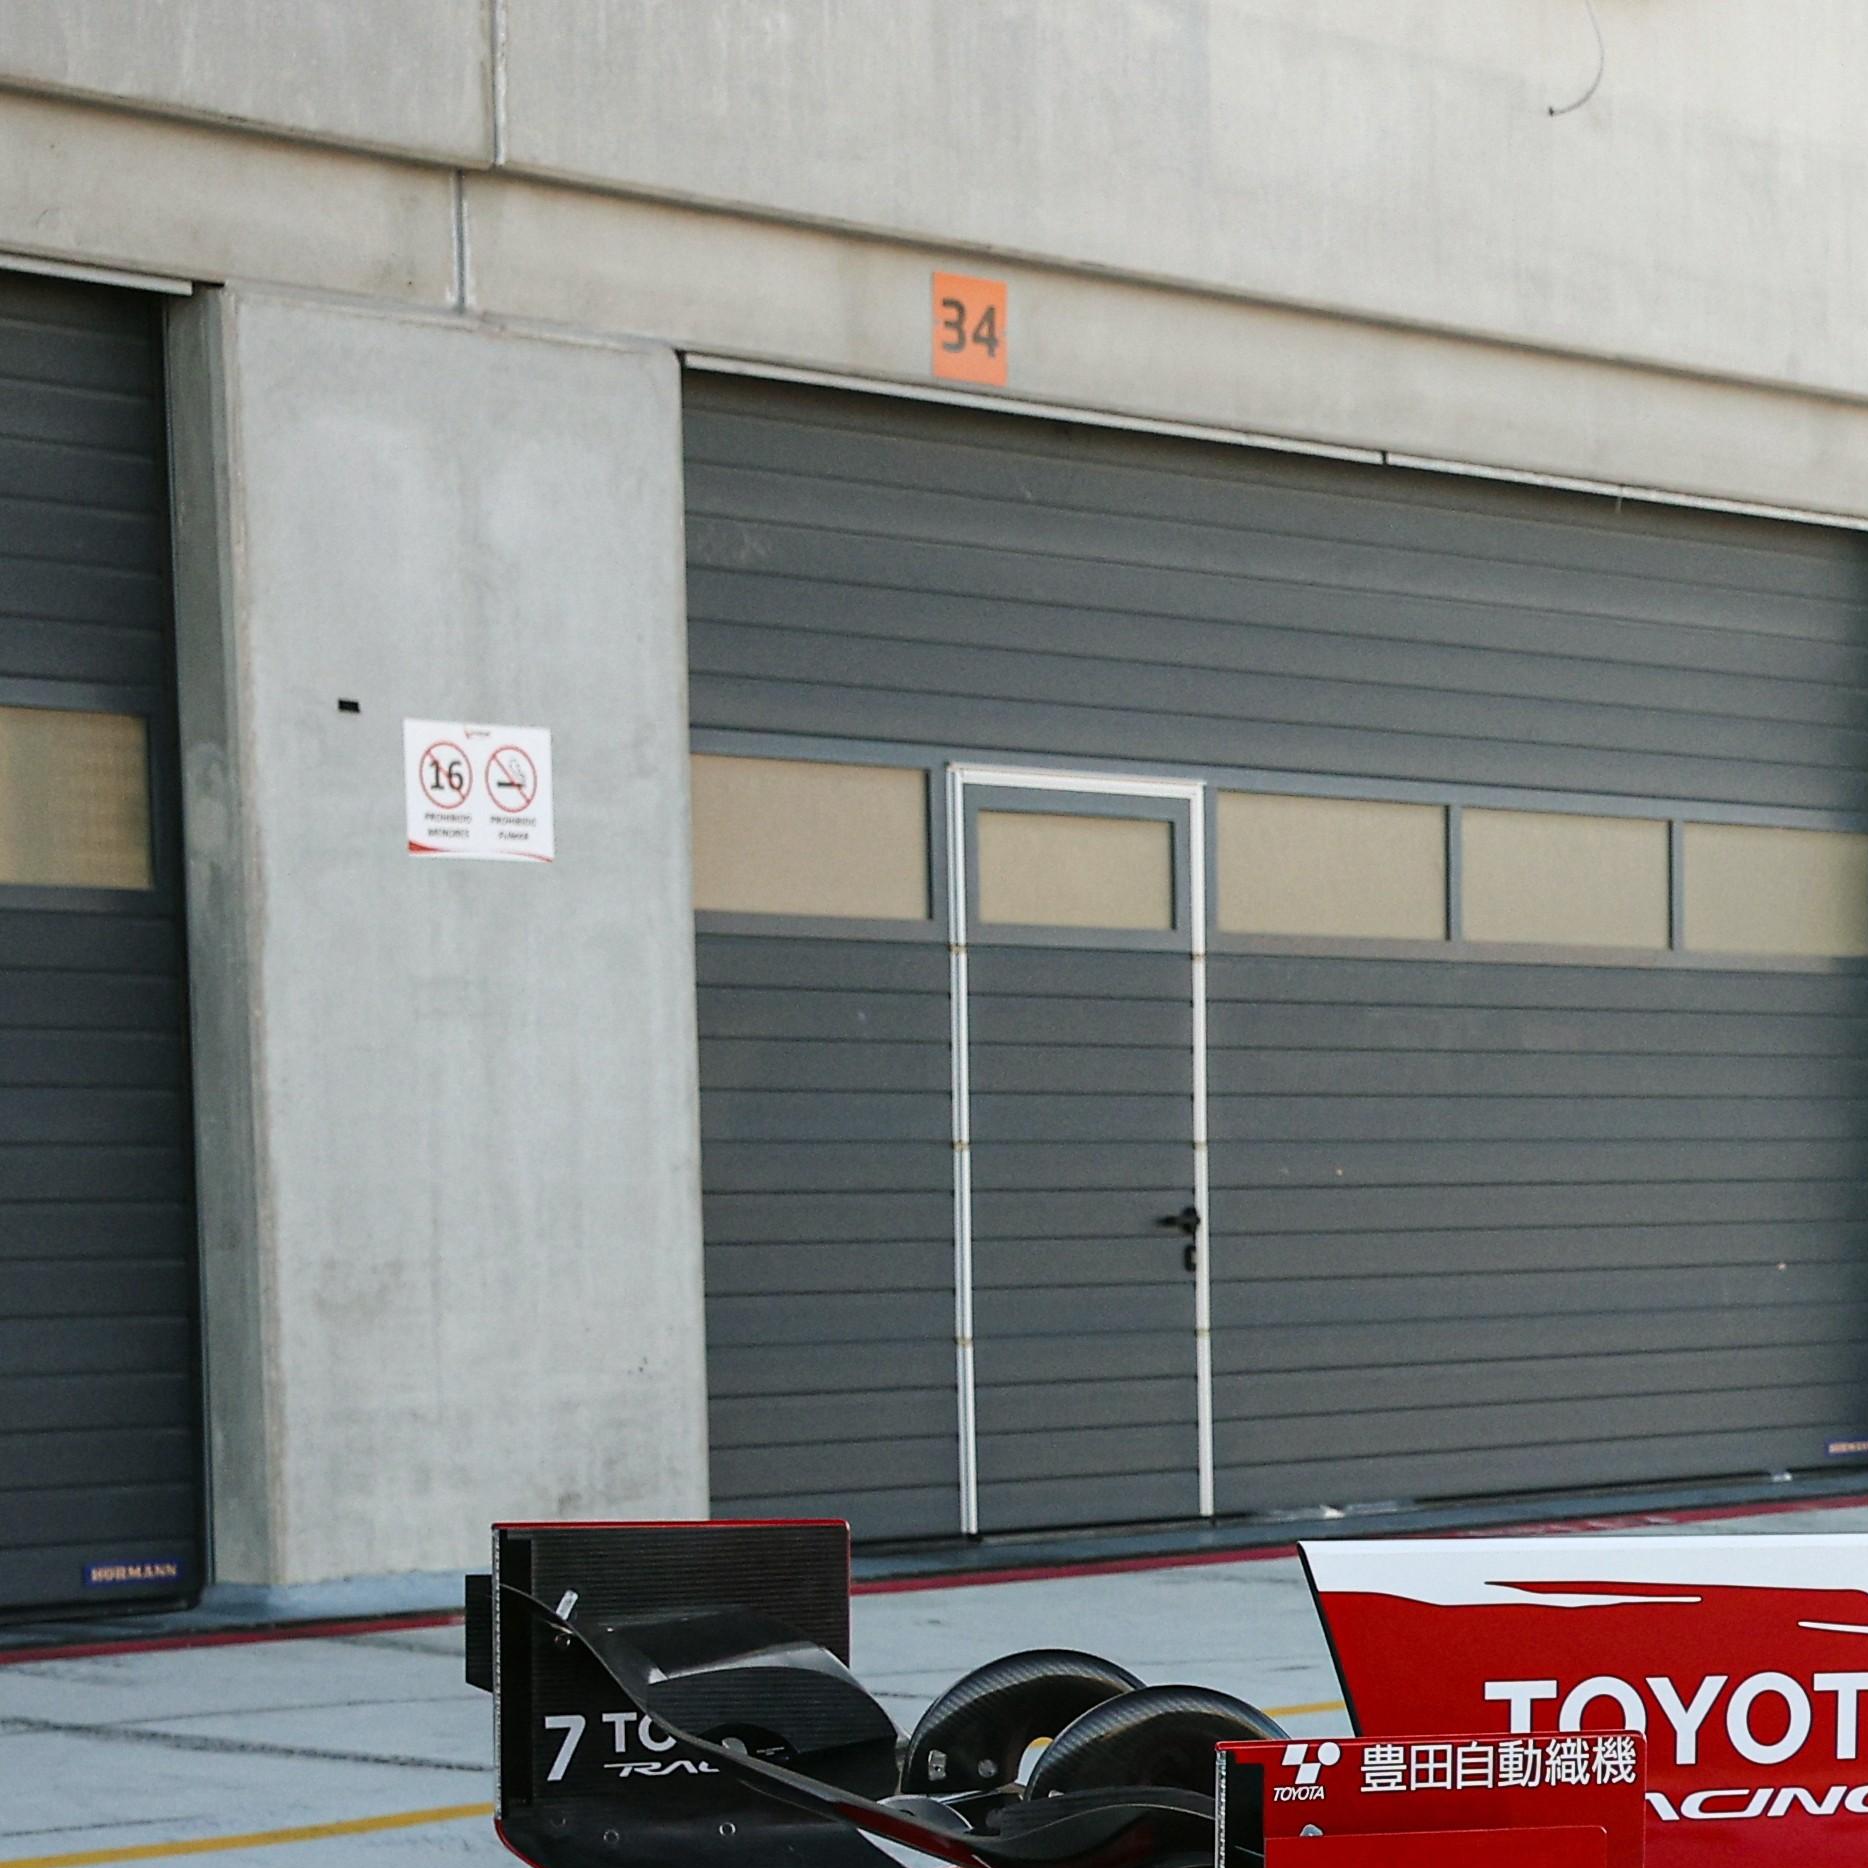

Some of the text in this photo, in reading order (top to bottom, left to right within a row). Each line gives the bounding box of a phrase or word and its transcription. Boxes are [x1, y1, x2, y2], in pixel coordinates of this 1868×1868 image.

[942, 297, 998, 358] 34
[429, 760, 464, 791] 16
[544, 1714, 586, 1782] 7
[1360, 1736, 1637, 1793] 豊田自動織機
[1273, 1786, 1326, 1802] TOYOTA
